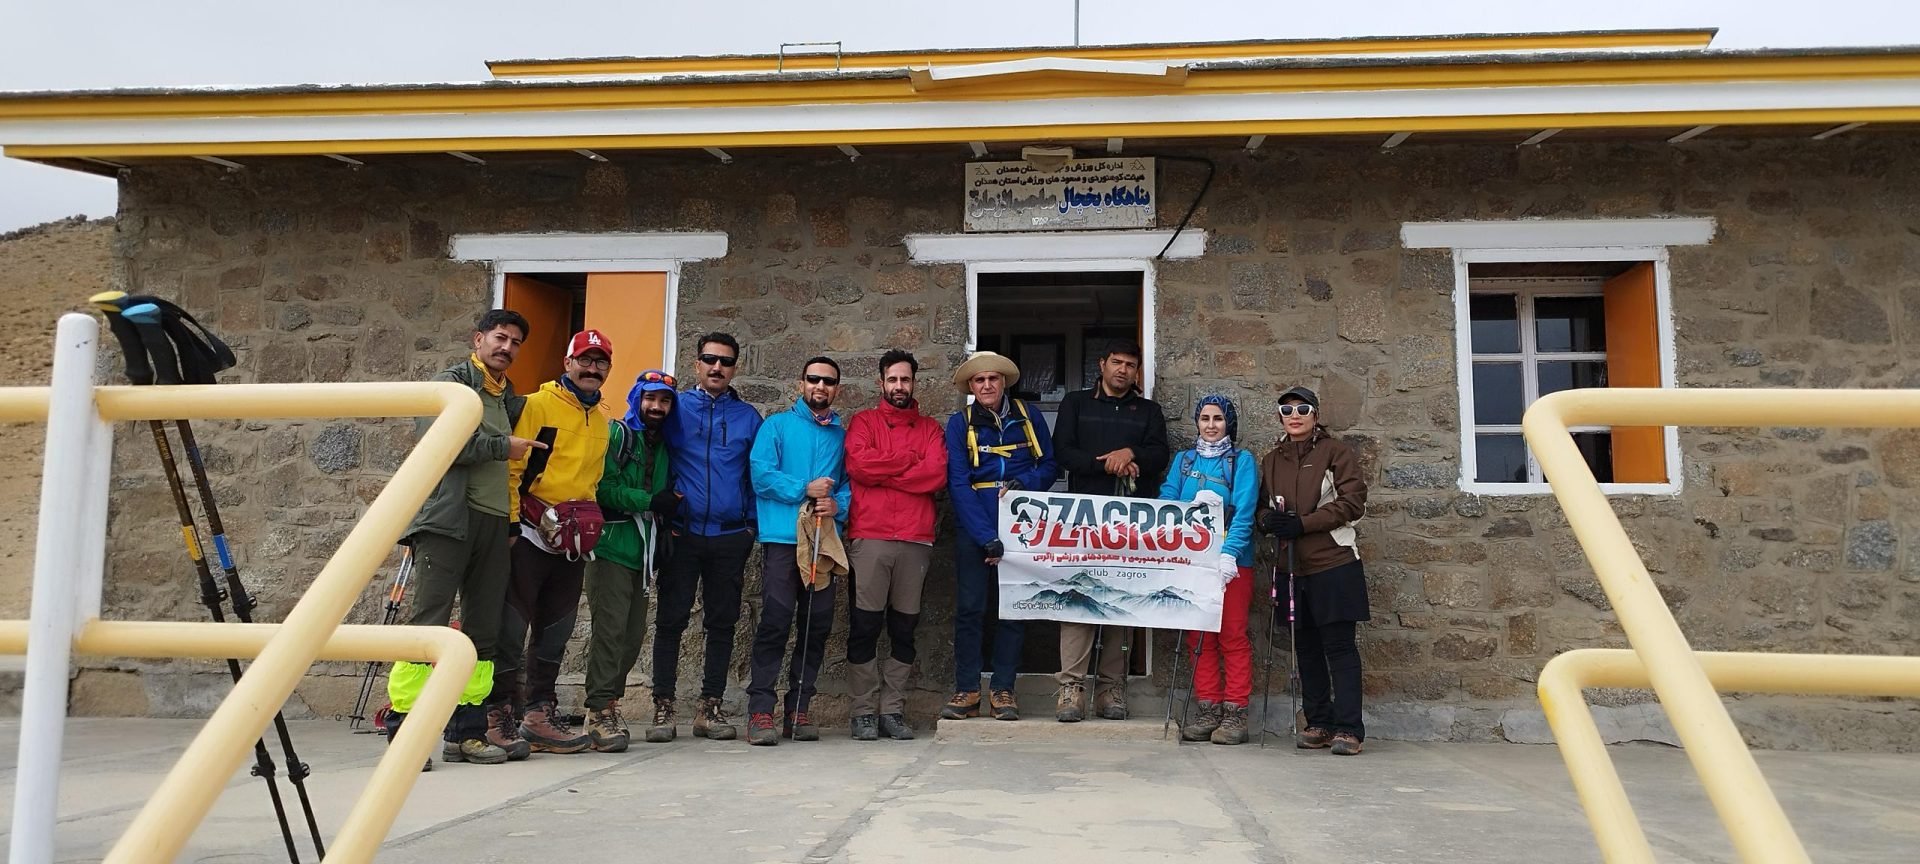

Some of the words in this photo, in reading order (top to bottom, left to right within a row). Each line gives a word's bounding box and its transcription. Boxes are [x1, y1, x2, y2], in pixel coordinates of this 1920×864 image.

[996, 165, 1020, 175] همدان
[1071, 162, 1093, 172] ورزش
[1095, 161, 1106, 171] کل
[1109, 161, 1123, 171] اداره
[974, 178, 998, 187] همدان
[998, 176, 1020, 187] استان
[1087, 173, 1124, 183] کوهنوردی
[1057, 186, 1102, 215] یخچال
[1104, 185, 1151, 214] پناهگاه
[588, 331, 602, 346] LA
[1047, 496, 1211, 552] ZAGROS
[1033, 552, 1055, 561] زاگرس
